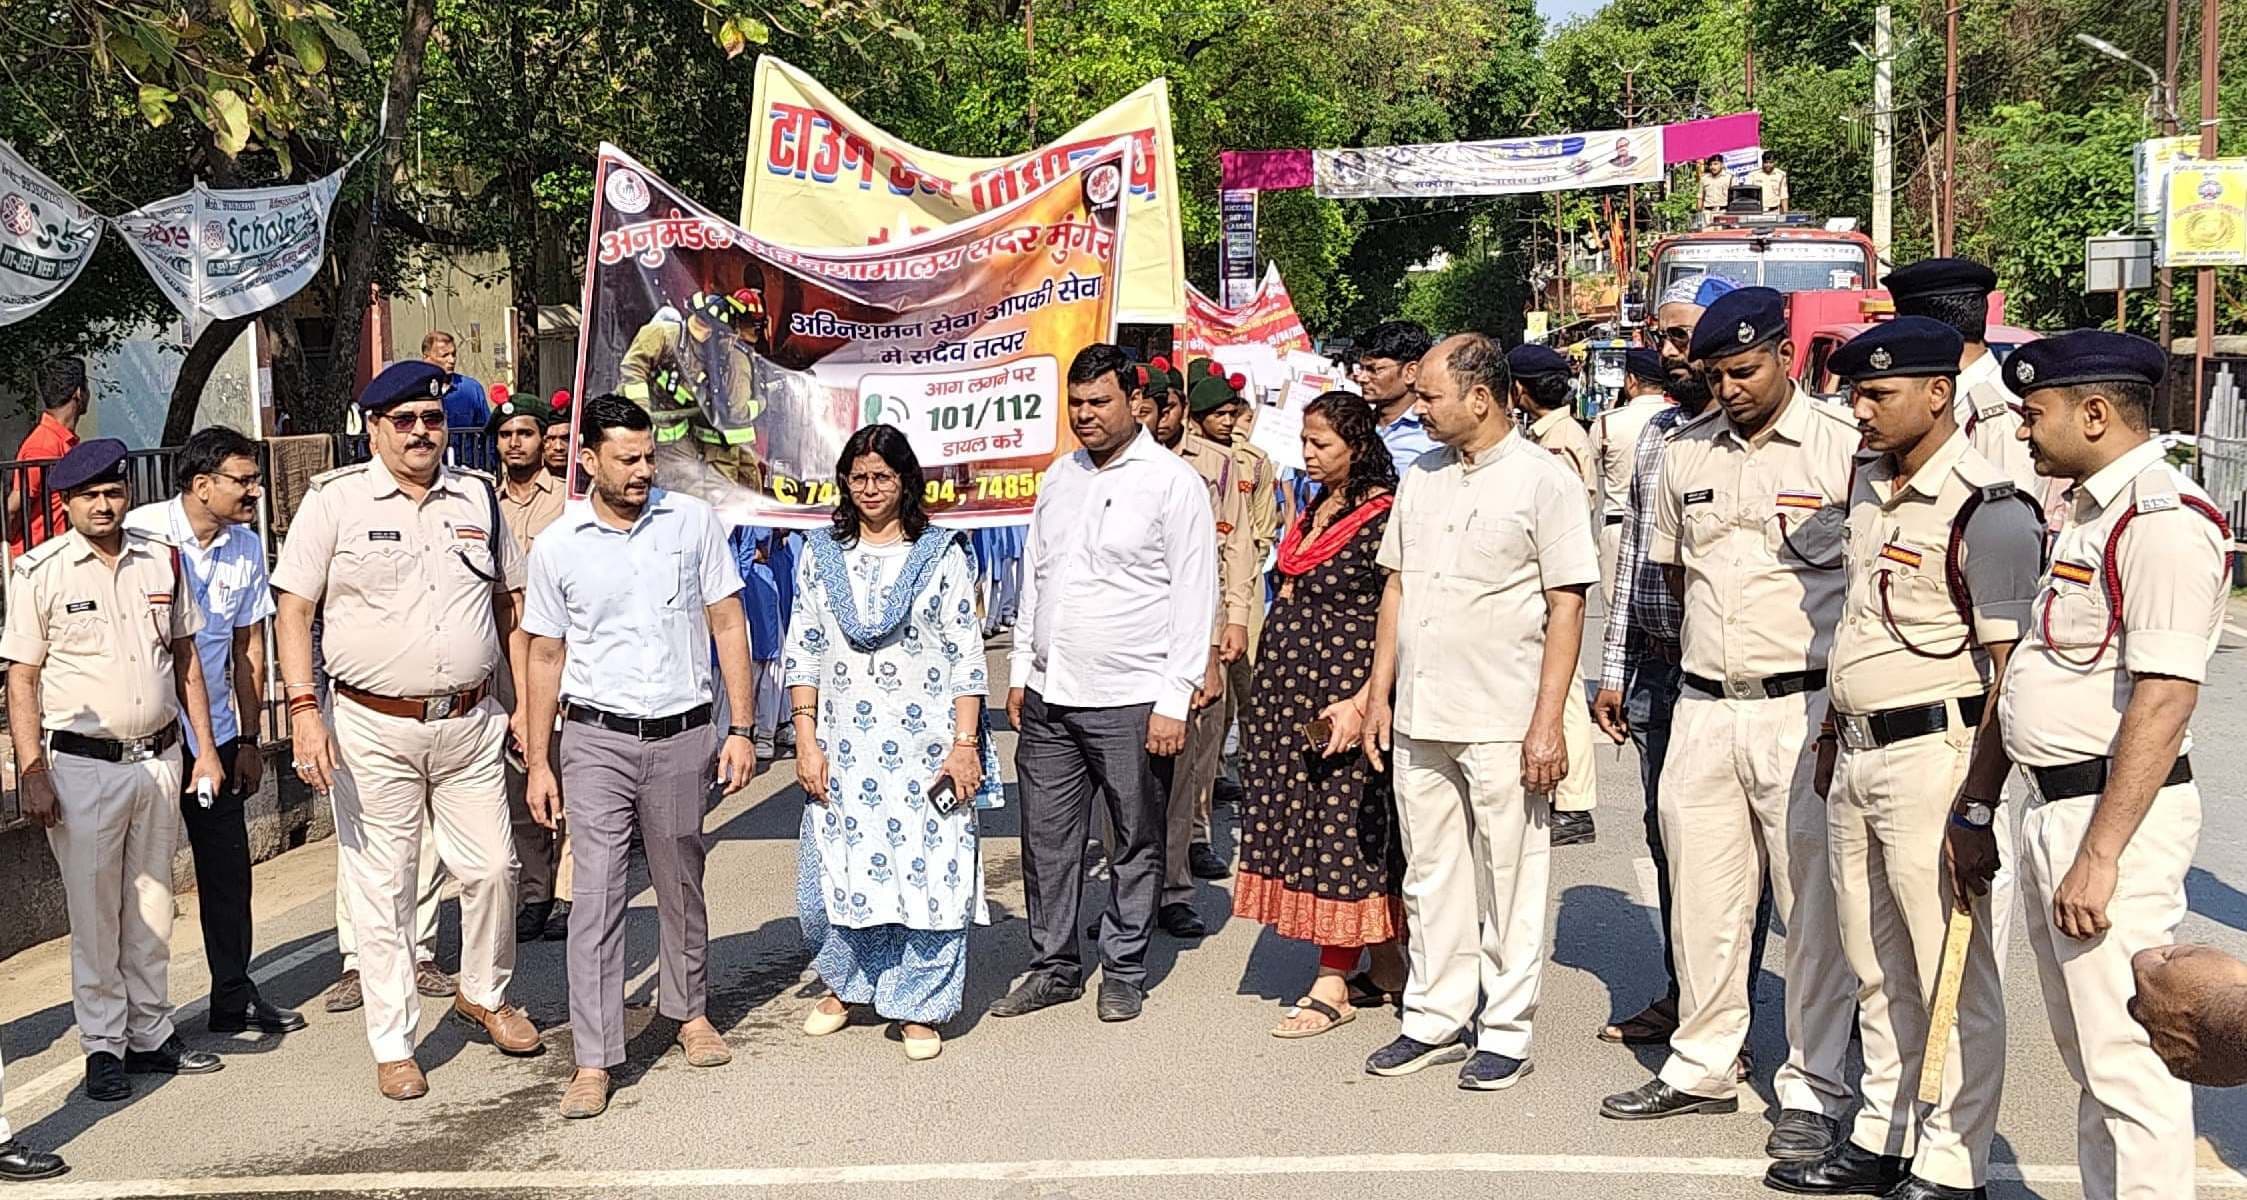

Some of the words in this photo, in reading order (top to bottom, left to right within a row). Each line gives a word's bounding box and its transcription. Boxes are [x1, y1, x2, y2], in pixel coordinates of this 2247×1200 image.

[969, 225, 1041, 259] सदर
[1045, 211, 1115, 266] मुंगेर
[792, 311, 923, 339] अग्निशमन
[929, 310, 978, 335] सेवा
[983, 278, 1054, 322] आपकी
[1057, 272, 1103, 300] सेवा
[909, 340, 967, 364] सदैव
[973, 331, 1027, 358] तत्पर
[925, 380, 965, 397] आग
[968, 368, 1010, 393] लगने
[1012, 367, 1038, 383] पर
[926, 393, 1042, 432] 101/112
[942, 436, 989, 457] डायल
[991, 428, 1024, 449] करें
